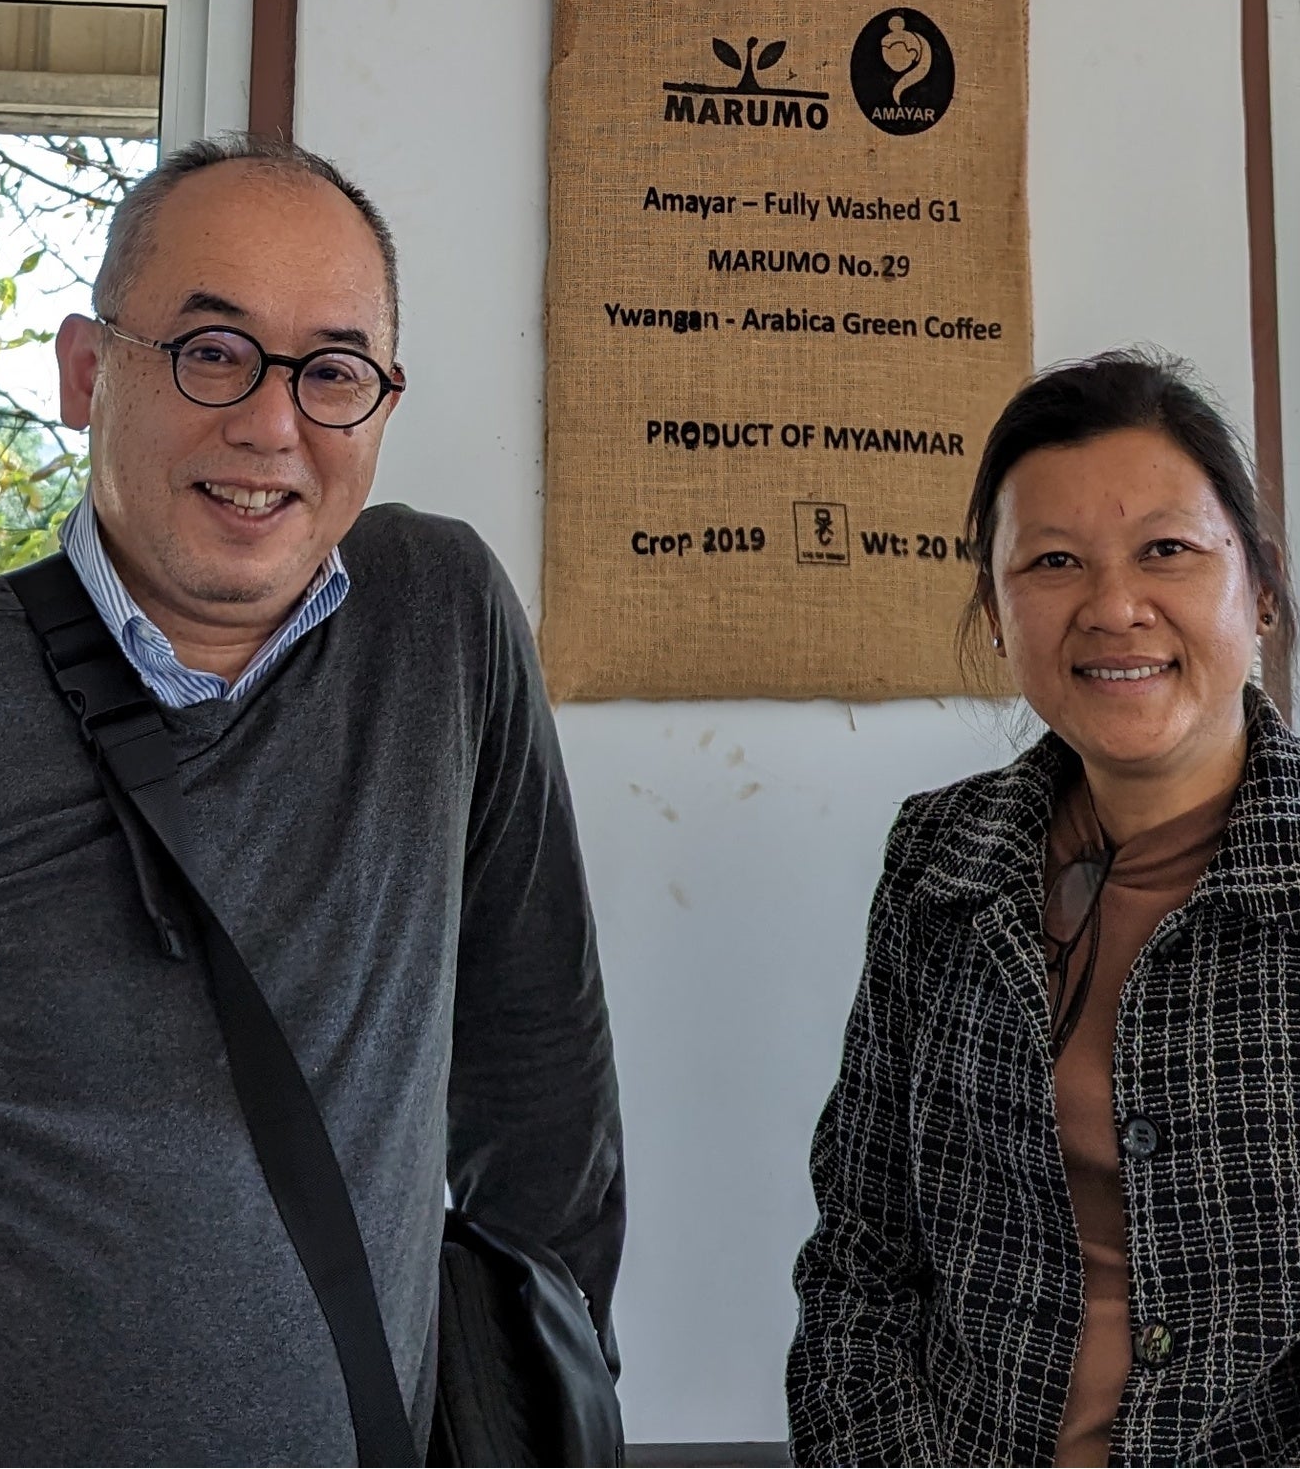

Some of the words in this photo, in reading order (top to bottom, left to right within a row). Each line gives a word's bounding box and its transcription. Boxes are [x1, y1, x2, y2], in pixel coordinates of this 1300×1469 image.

[663, 94, 829, 131] MARUMO
[871, 106, 936, 122] AMAYAR
[643, 186, 737, 220] Amayar
[764, 191, 820, 222] Fully
[827, 195, 921, 221] Washed
[928, 199, 962, 223] G1
[708, 249, 831, 274] MARUMO
[838, 253, 910, 279] No.29
[741, 307, 836, 333] Arabica
[842, 312, 918, 337] Green
[924, 315, 1002, 340] Coffee
[646, 420, 774, 450] PRODUCT
[780, 423, 816, 449] OF
[823, 425, 965, 456] MYANMAR
[631, 530, 693, 557] Crop
[702, 526, 766, 554] 2019
[860, 531, 909, 557] Wt:
[916, 533, 948, 562] 20
